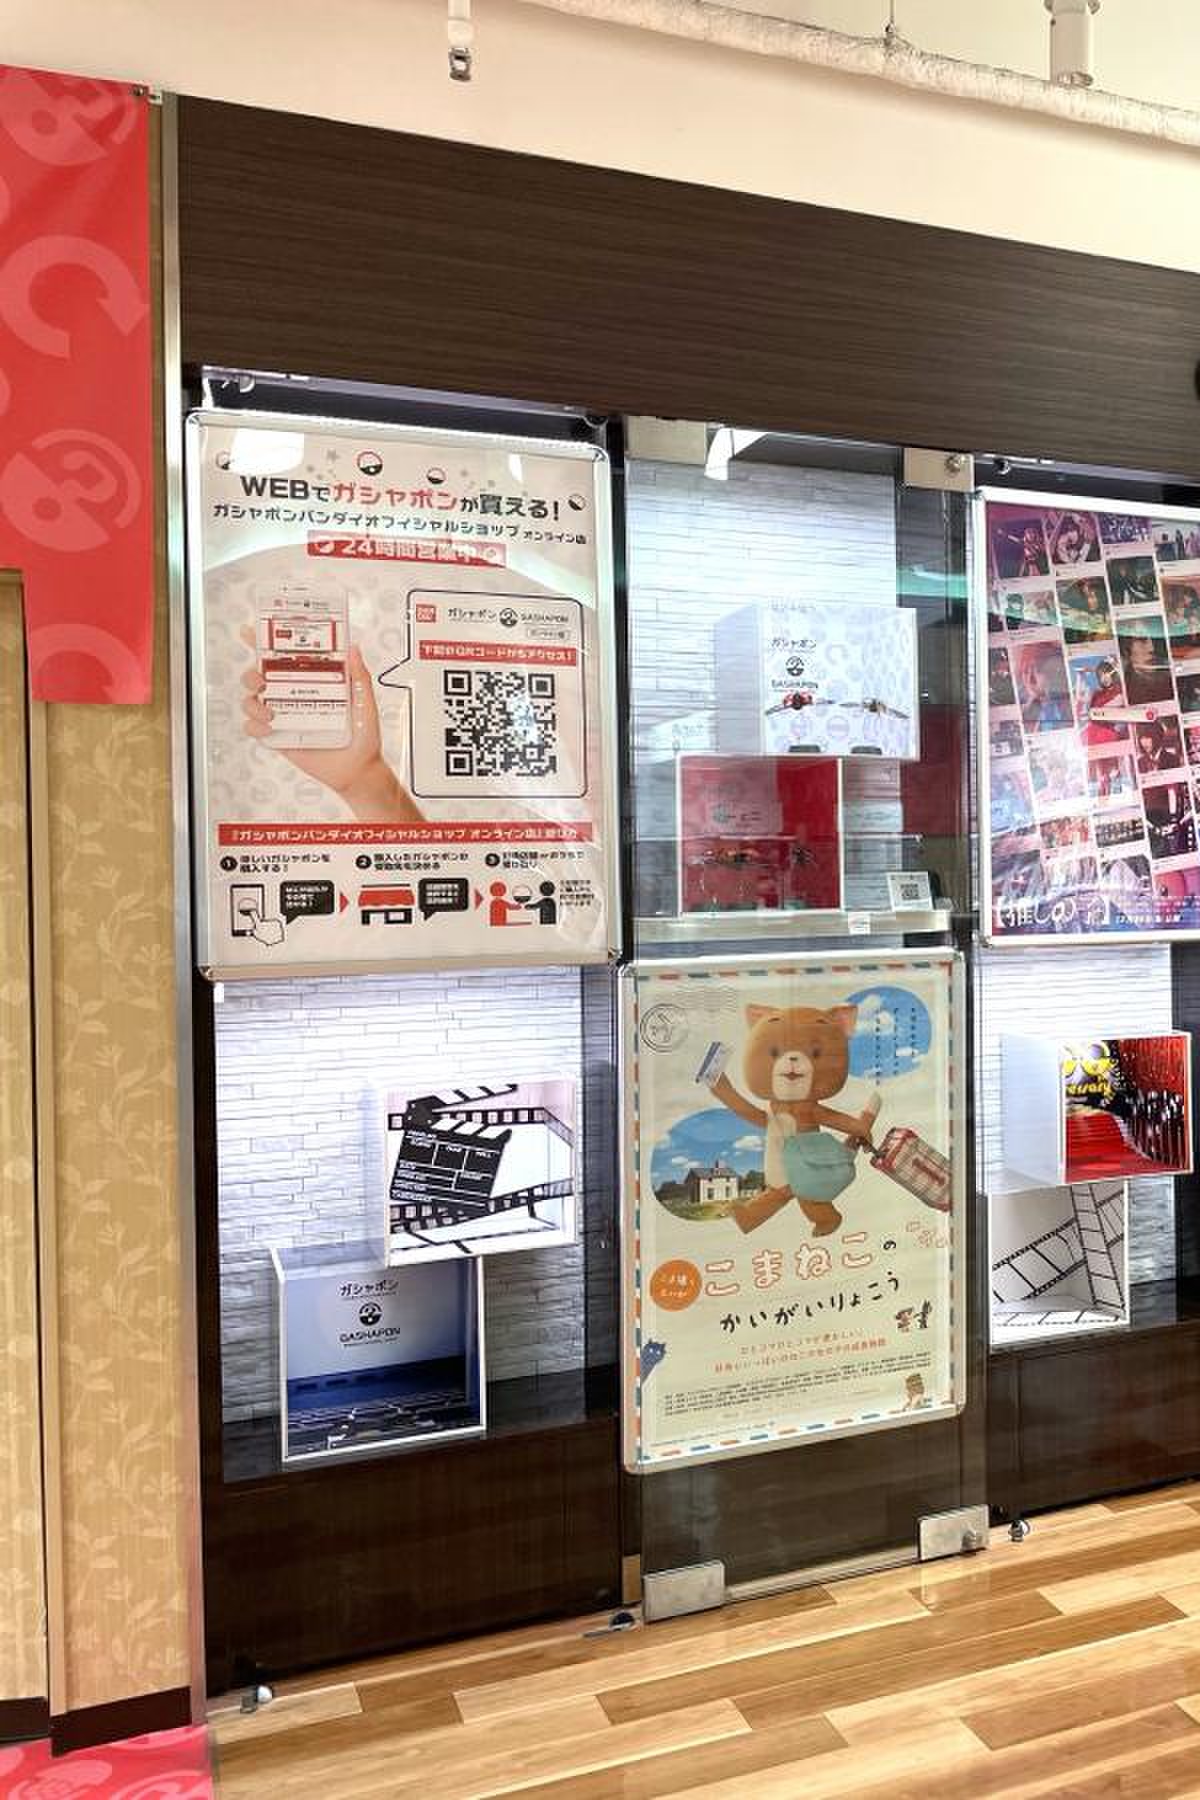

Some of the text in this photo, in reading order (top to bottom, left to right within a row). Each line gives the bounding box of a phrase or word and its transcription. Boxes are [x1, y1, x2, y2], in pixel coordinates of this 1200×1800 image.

[339, 1279, 400, 1297] ガシャポン
[719, 1270, 901, 1334] かいがいりょこう
